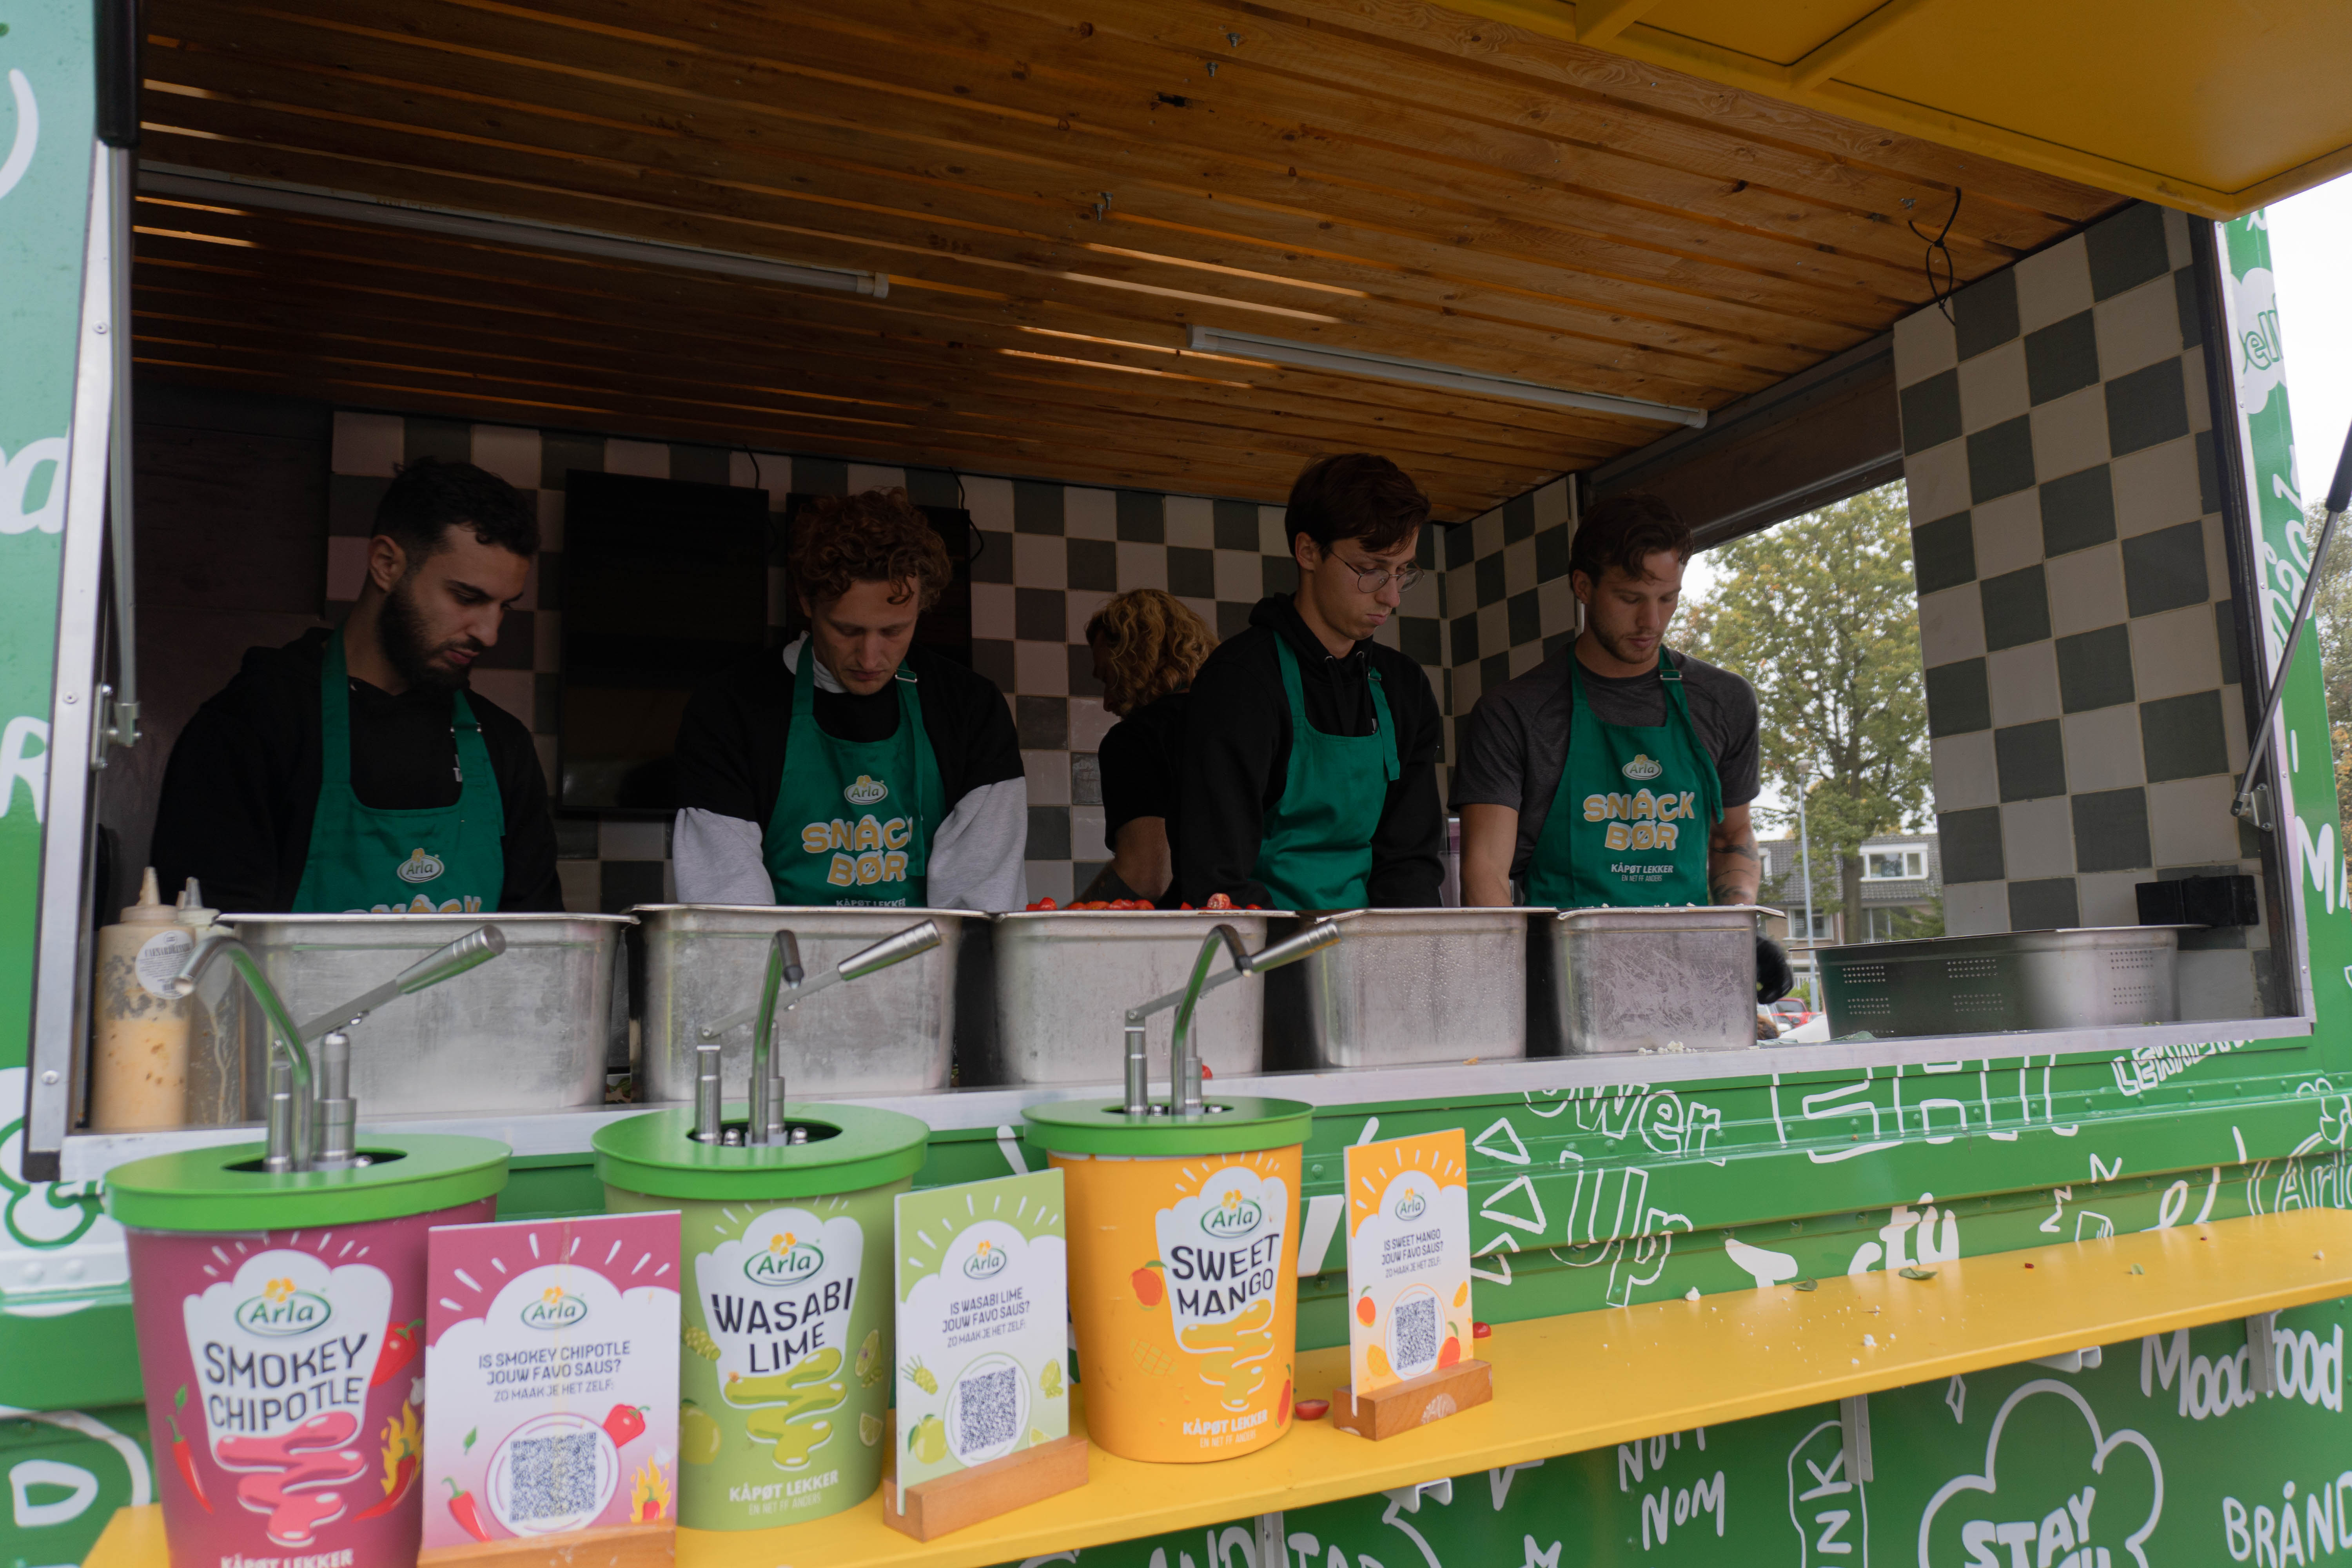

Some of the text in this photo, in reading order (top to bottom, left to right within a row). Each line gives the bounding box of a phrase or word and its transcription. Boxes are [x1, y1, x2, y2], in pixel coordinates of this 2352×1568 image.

[1629, 761, 1655, 774] Arla
[851, 785, 879, 798] Arla
[1604, 820, 1679, 851] BØR
[406, 862, 433, 875] Arla
[827, 850, 908, 887] BØR
[1611, 862, 1673, 874] KÅPØT LEKKER
[1211, 1205, 1253, 1229] Arla
[1400, 1198, 1421, 1214] Arla
[1384, 1228, 1441, 1251] IS SWEET MANGO
[757, 1252, 811, 1276] Arla
[970, 1254, 999, 1272] Arla
[1171, 1233, 1279, 1281] SWEET
[1382, 1241, 1443, 1265] JOUW FAVO SAUS?
[1410, 1262, 1416, 1272] JE
[1417, 1259, 1426, 1269] HET
[711, 1277, 853, 1334] WASABI
[950, 1287, 1023, 1316] IS WASABI LIME
[1177, 1269, 1274, 1318] MANGO
[249, 1299, 314, 1325] Arla
[531, 1302, 575, 1321] Arla
[942, 1301, 1030, 1333] JOUW FAVO SAUS?
[749, 1321, 826, 1373] LIME
[947, 1336, 957, 1348] ZO
[959, 1331, 980, 1345] MAAK
[982, 1328, 990, 1339] JE
[992, 1323, 1006, 1336] HET
[204, 1333, 368, 1388] SMOKEY
[479, 1340, 630, 1369] IS SMOKEY CHIPOTLE
[486, 1359, 621, 1385] JOUW FAVO SAUS?
[208, 1377, 363, 1432] CHIPOTLE
[494, 1390, 508, 1403] ZO
[511, 1387, 544, 1401] MAAK
[547, 1385, 558, 1396] JE
[562, 1382, 583, 1395] HET
[1183, 1409, 1268, 1435] KÅPØT LEKKER
[1200, 1437, 1209, 1448] EN
[1212, 1436, 1223, 1447] NET
[729, 1469, 838, 1501] KÅPØT LEKKER
[749, 1503, 760, 1515] EN
[762, 1501, 778, 1514] NET
[792, 1492, 822, 1508] ANDERS
[1642, 1470, 1725, 1551] NOM
